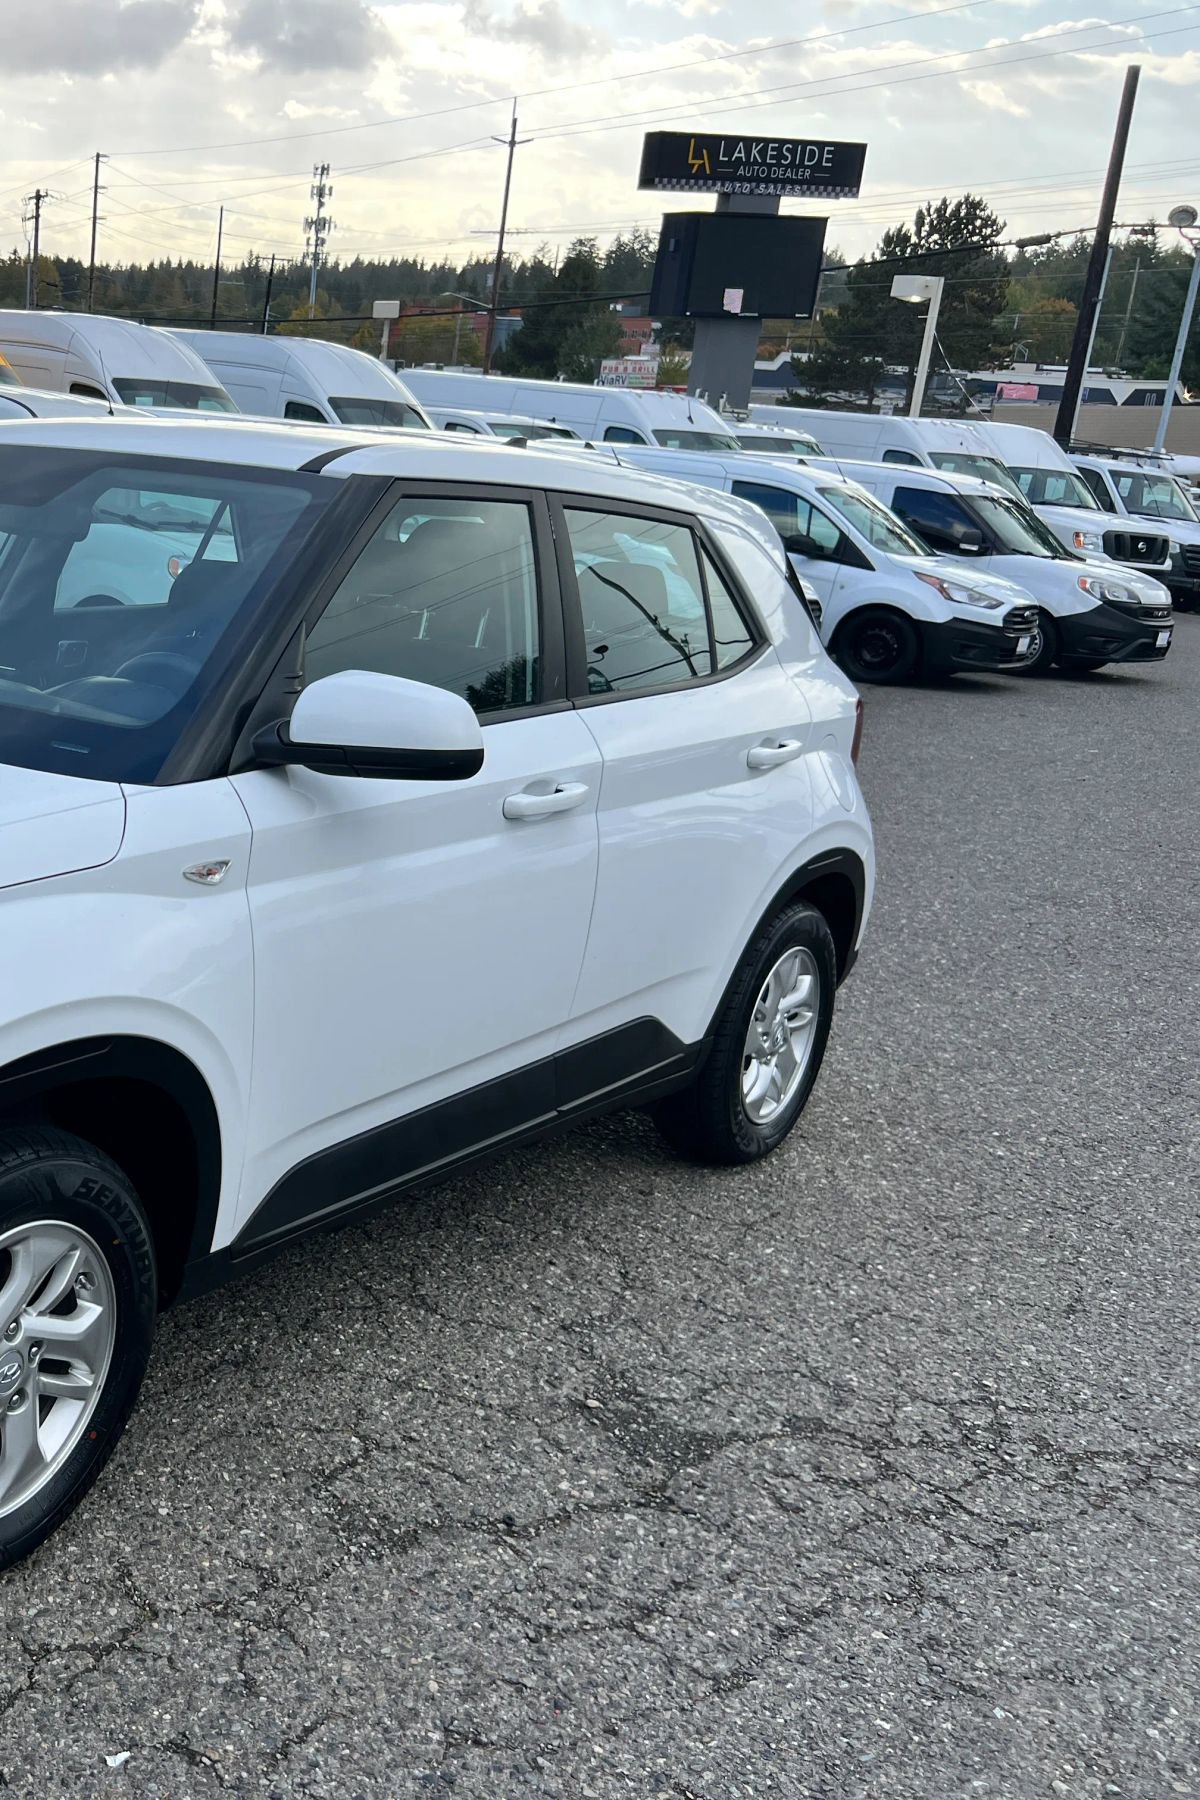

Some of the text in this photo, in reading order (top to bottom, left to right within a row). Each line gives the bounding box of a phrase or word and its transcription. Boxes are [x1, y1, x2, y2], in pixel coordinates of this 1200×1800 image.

[719, 140, 835, 167] LAKESIDE
[737, 165, 811, 180] AUTO DEALER
[714, 183, 801, 196] AUTO SALES
